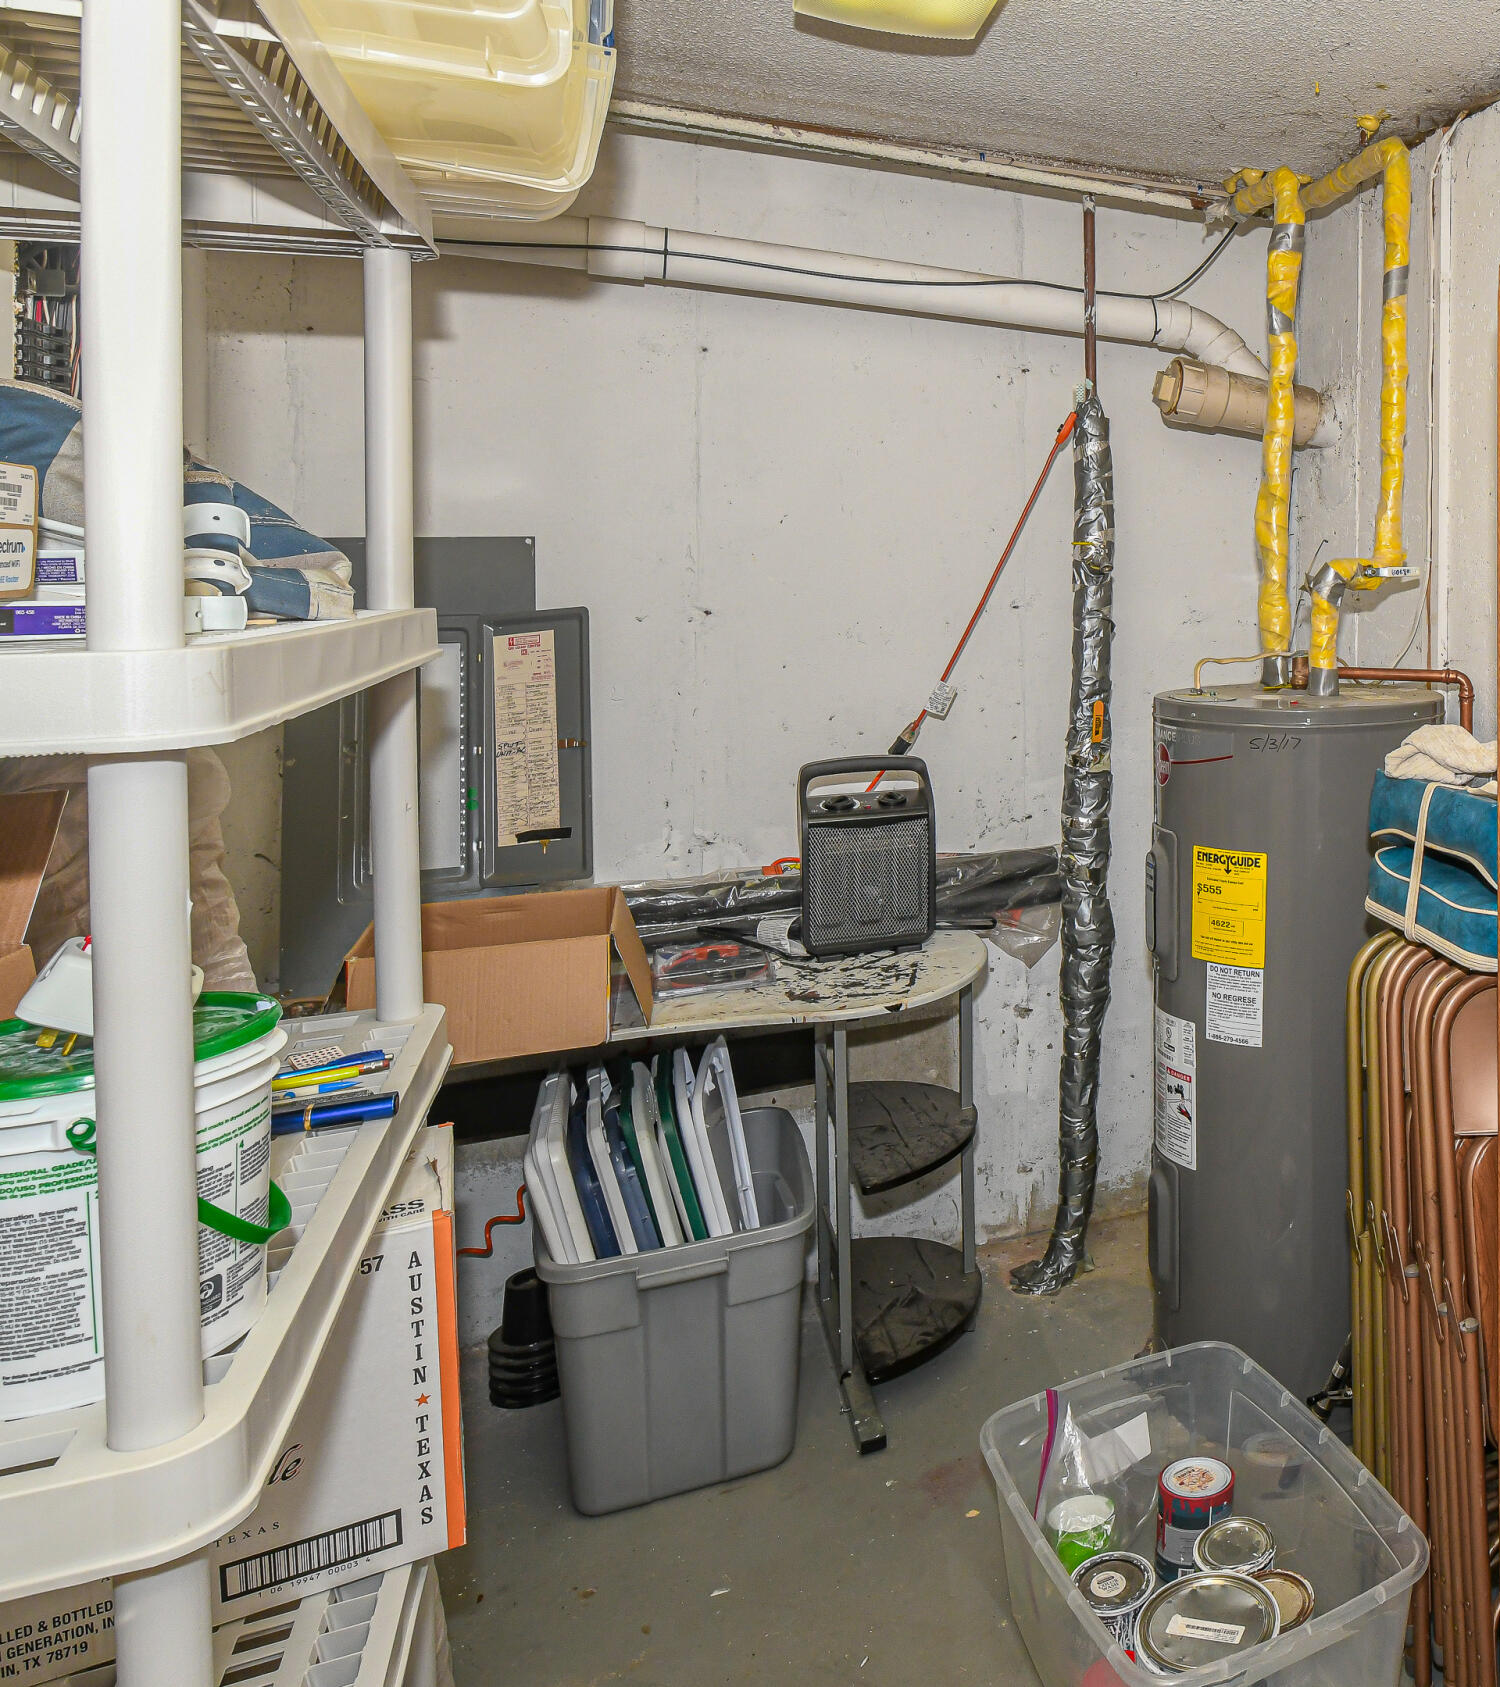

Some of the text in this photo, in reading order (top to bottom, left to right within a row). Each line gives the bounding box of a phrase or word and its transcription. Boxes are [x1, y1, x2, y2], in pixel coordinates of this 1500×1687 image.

[1249, 733, 1302, 752] 5/3/17
[1197, 851, 1261, 868] ENERGYGUIDE
[1197, 882, 1222, 895] $555
[1211, 919, 1231, 929] 4622
[1210, 965, 1260, 978] DO NOT RETURN
[1223, 994, 1257, 1005] REGRESE
[239, 1139, 245, 1149] 4
[400, 1207, 425, 1217] CARE
[407, 1250, 434, 1526] AUSTIN TEXAS
[213, 1520, 281, 1549] TEXAS
[290, 1572, 321, 1588] 19947
[327, 1560, 359, 1576] 00003
[37, 1620, 48, 1633] &
[52, 1600, 113, 1629] BOTTLED
[6, 1621, 98, 1660] GENERATION,
[23, 1655, 41, 1671] TX
[46, 1641, 88, 1664] 78719
